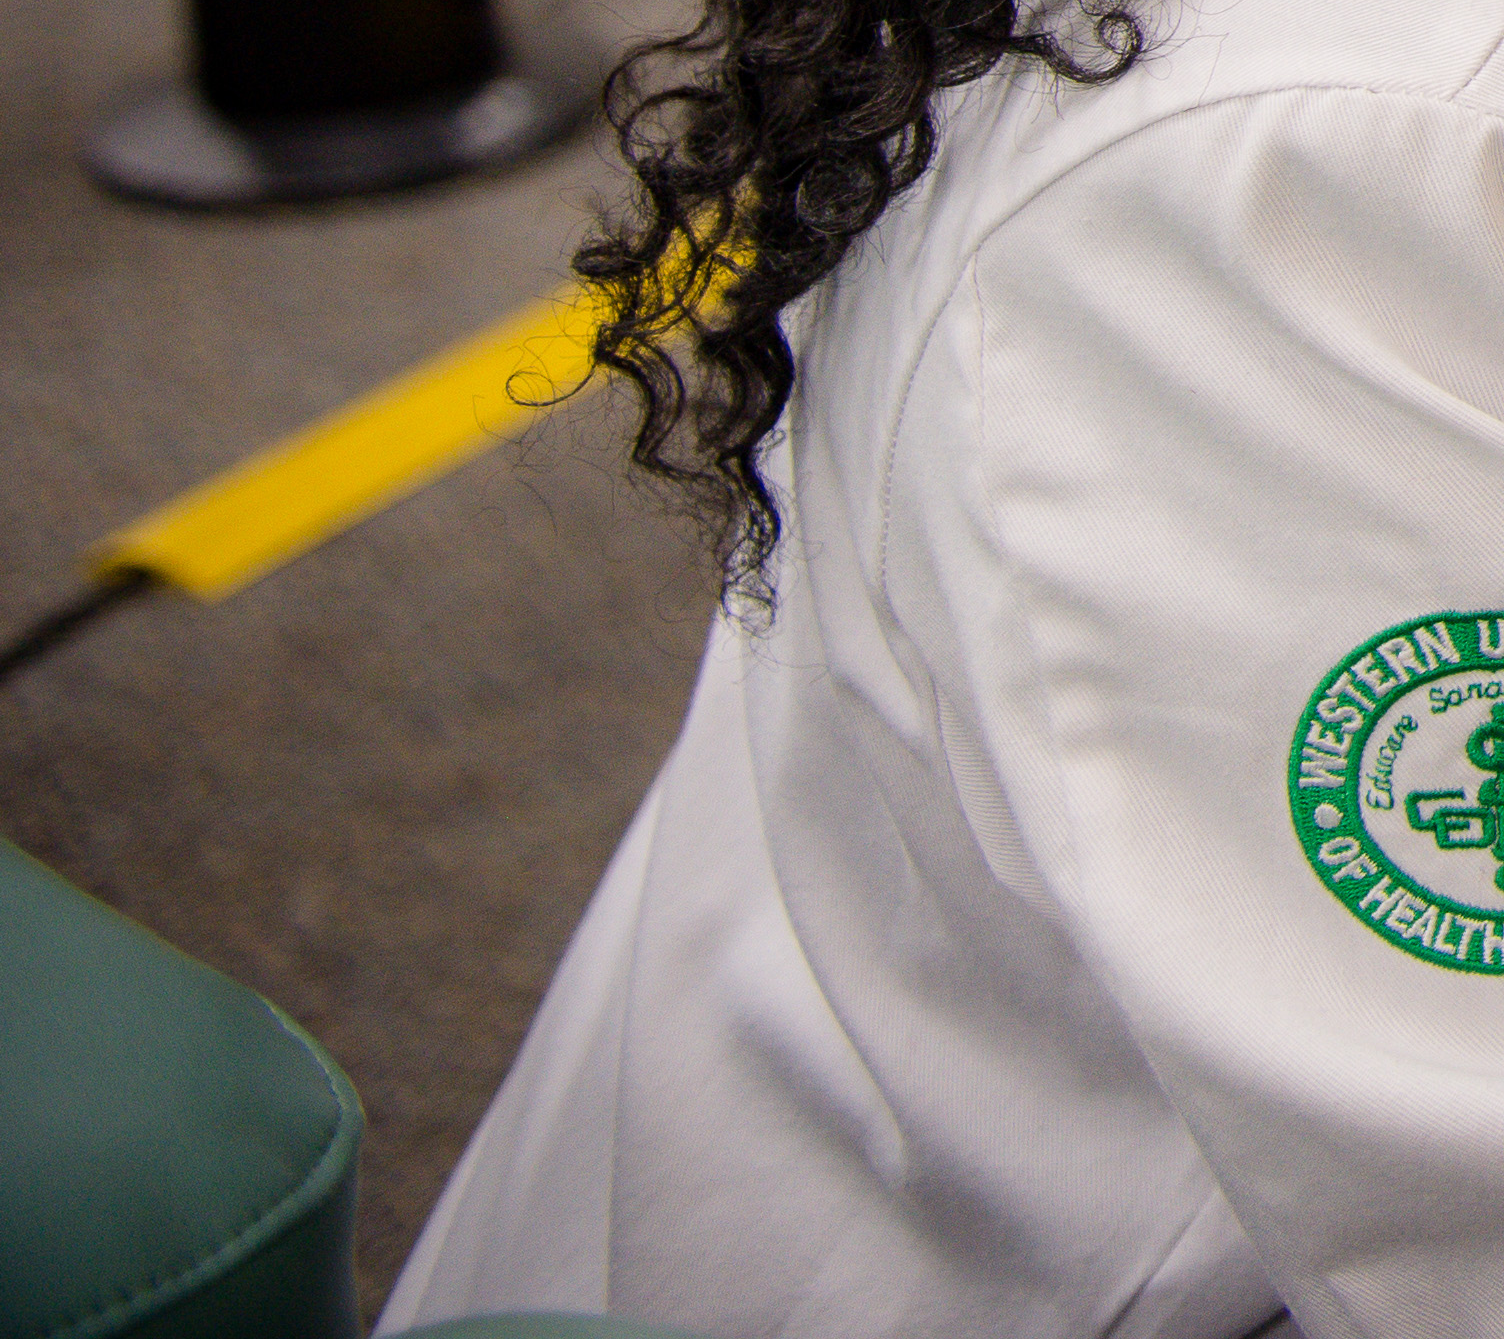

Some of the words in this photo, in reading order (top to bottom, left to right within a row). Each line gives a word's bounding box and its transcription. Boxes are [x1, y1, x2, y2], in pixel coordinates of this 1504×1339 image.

[1298, 620, 1461, 789] WESTERN
[1366, 714, 1418, 810] Educare
[1318, 836, 1378, 883] OF
